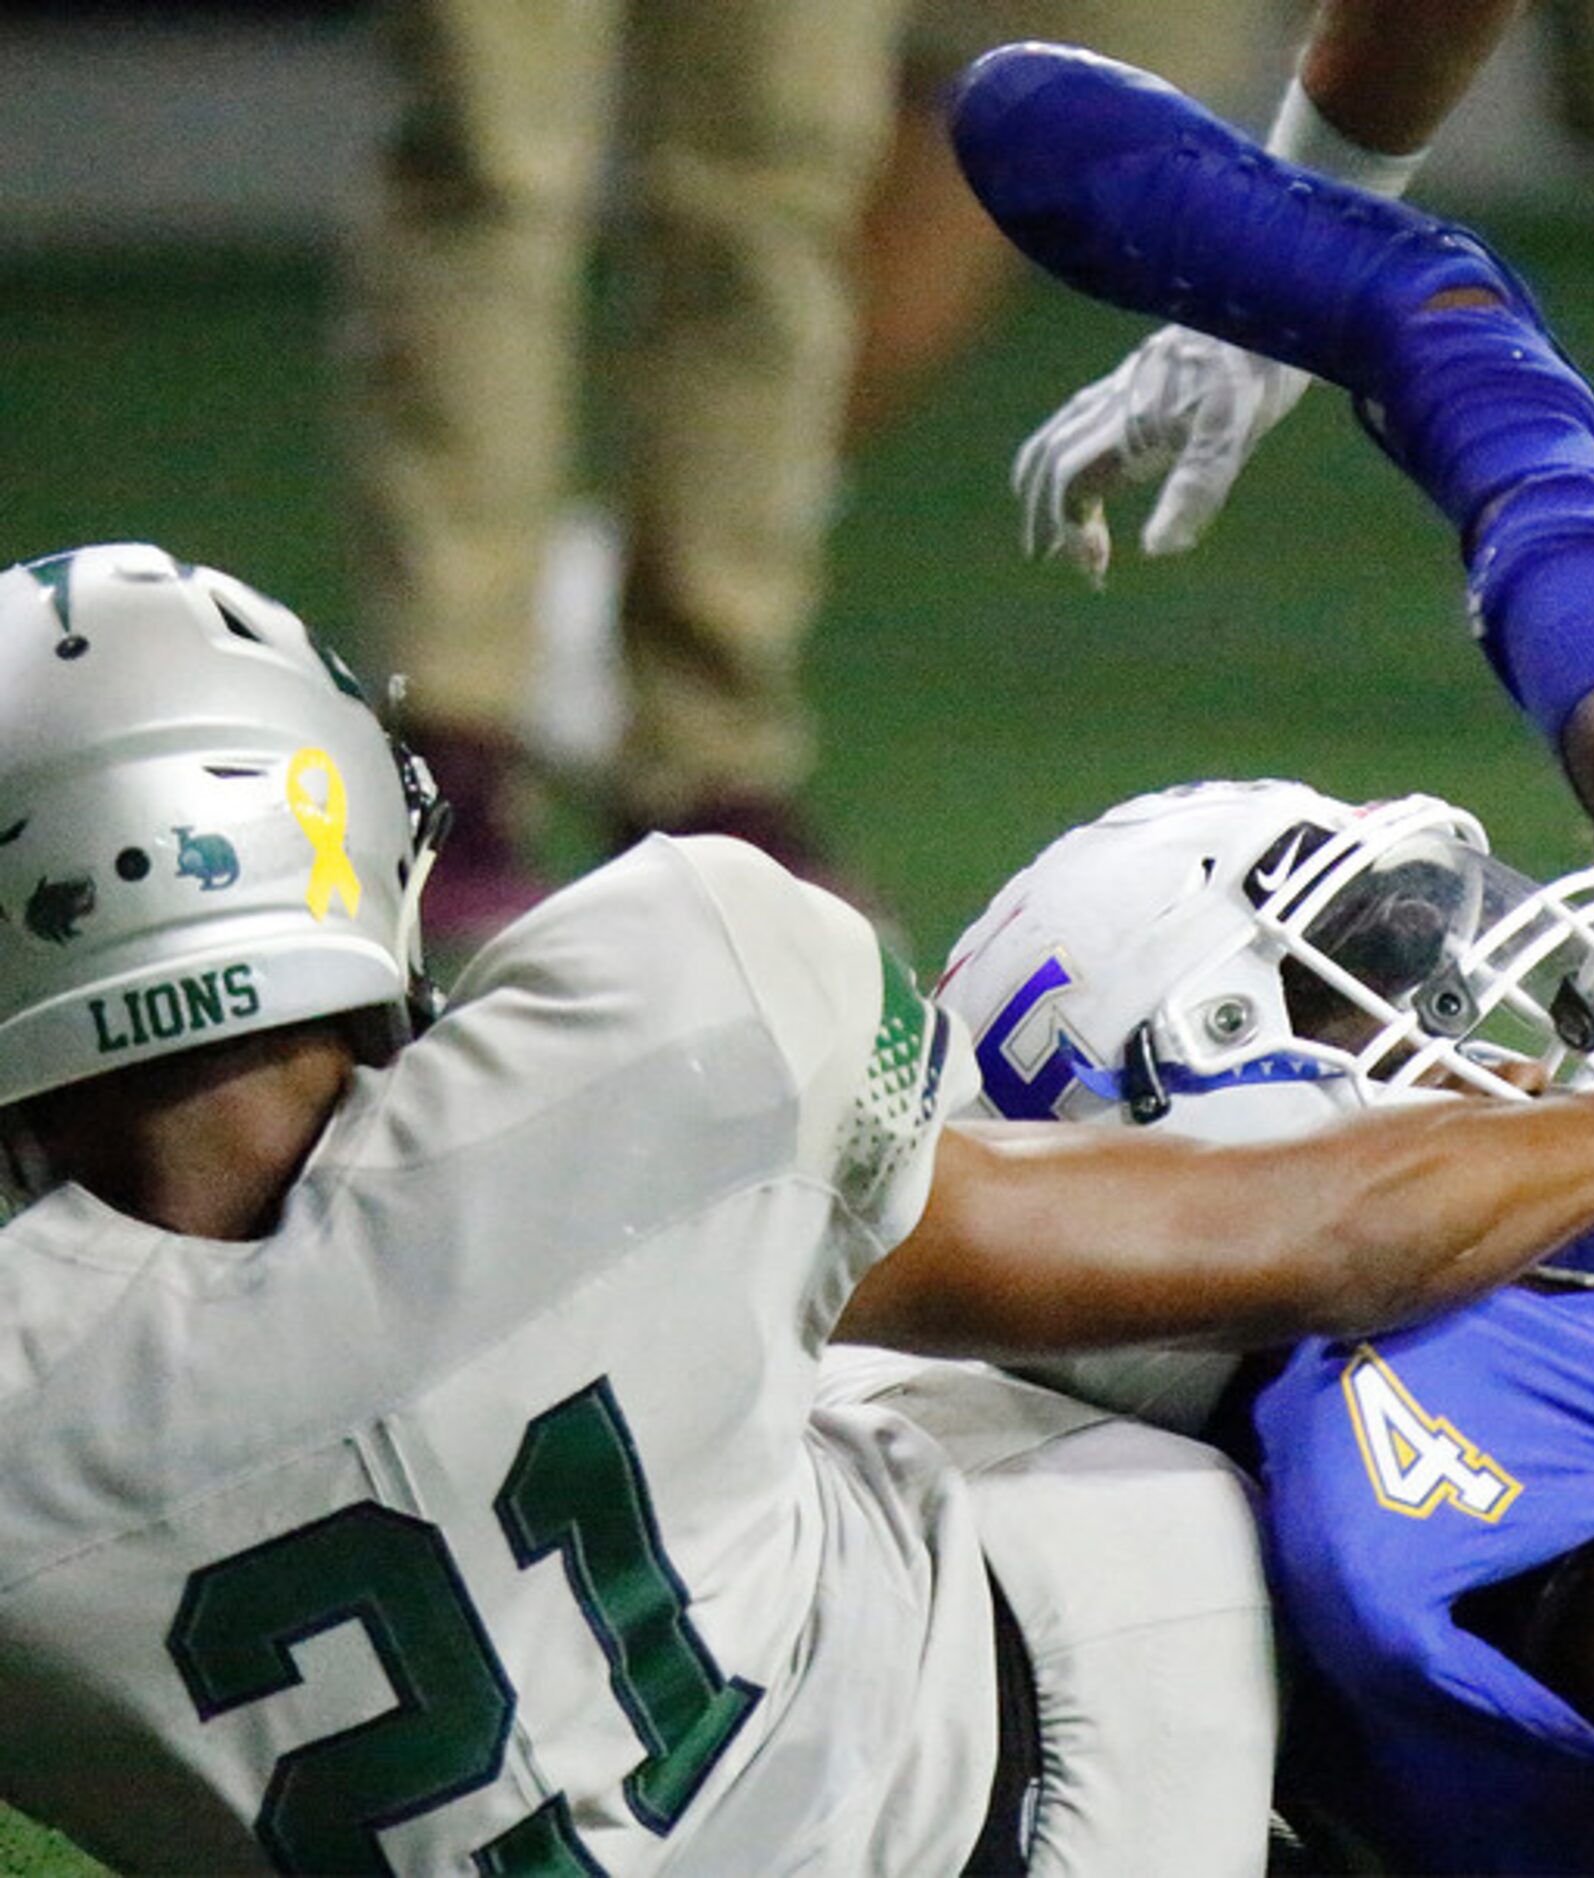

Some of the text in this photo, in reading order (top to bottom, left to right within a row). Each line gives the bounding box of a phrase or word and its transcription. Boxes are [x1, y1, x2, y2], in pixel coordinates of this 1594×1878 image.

[89, 963, 260, 1053] LIONS
[1341, 1343, 1525, 1523] 4
[165, 1374, 766, 1878] 21
